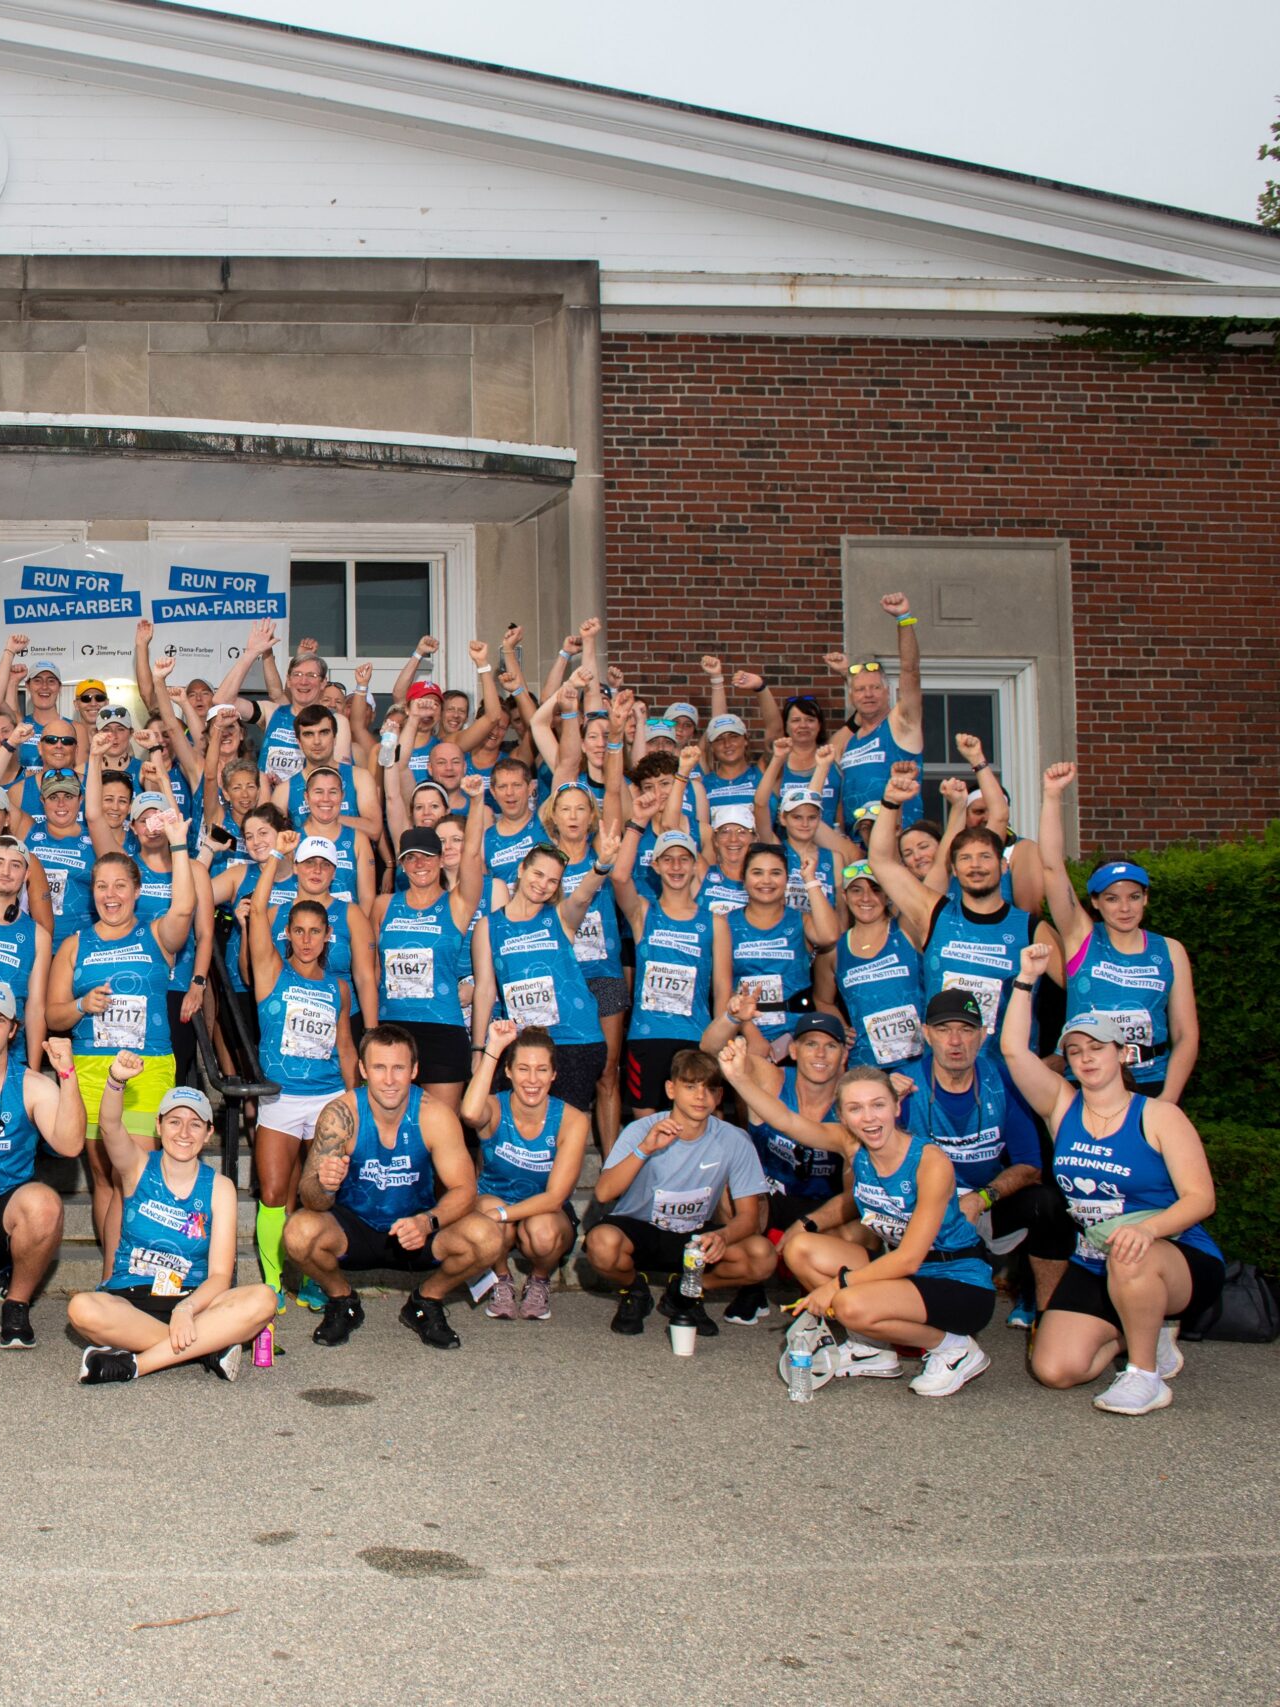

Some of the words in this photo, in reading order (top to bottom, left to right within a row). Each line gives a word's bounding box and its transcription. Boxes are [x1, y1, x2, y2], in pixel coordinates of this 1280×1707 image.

[33, 572, 70, 589] RUN
[75, 576, 110, 593] FOR
[180, 572, 217, 589] RUN
[222, 577, 257, 593] FOR
[13, 598, 133, 619] DANA-FARBER
[161, 599, 279, 619] DANA-FARBER
[277, 749, 294, 757] Scott
[270, 757, 299, 768] 11671
[310, 839, 329, 849] PMC
[53, 855, 85, 868] INSTITUTE
[501, 945, 526, 953] CANCER
[526, 942, 556, 950] INSTITUTE
[396, 952, 419, 960] Alison
[942, 949, 971, 960] CANCER
[972, 954, 1010, 968] INSTITUTE
[390, 963, 428, 975] 11647
[652, 965, 688, 976] Nathaniel
[872, 967, 907, 979] INSTITUTE
[649, 975, 689, 991] 11757
[958, 977, 983, 988] David
[1093, 968, 1125, 985] CANCER
[1124, 979, 1164, 990] INSTITUTE
[510, 981, 544, 992] Kimberly
[284, 994, 309, 1004] CANCER
[511, 990, 550, 1008] 11678
[101, 1009, 141, 1023] 11717
[302, 1008, 321, 1018] Cara
[871, 1010, 907, 1024] Shannon
[291, 1018, 331, 1036] 11637
[873, 1018, 916, 1040] 11759
[1069, 1141, 1113, 1157] JULIE'S
[140, 1205, 167, 1223] CANCER
[660, 1201, 704, 1216] 11097
